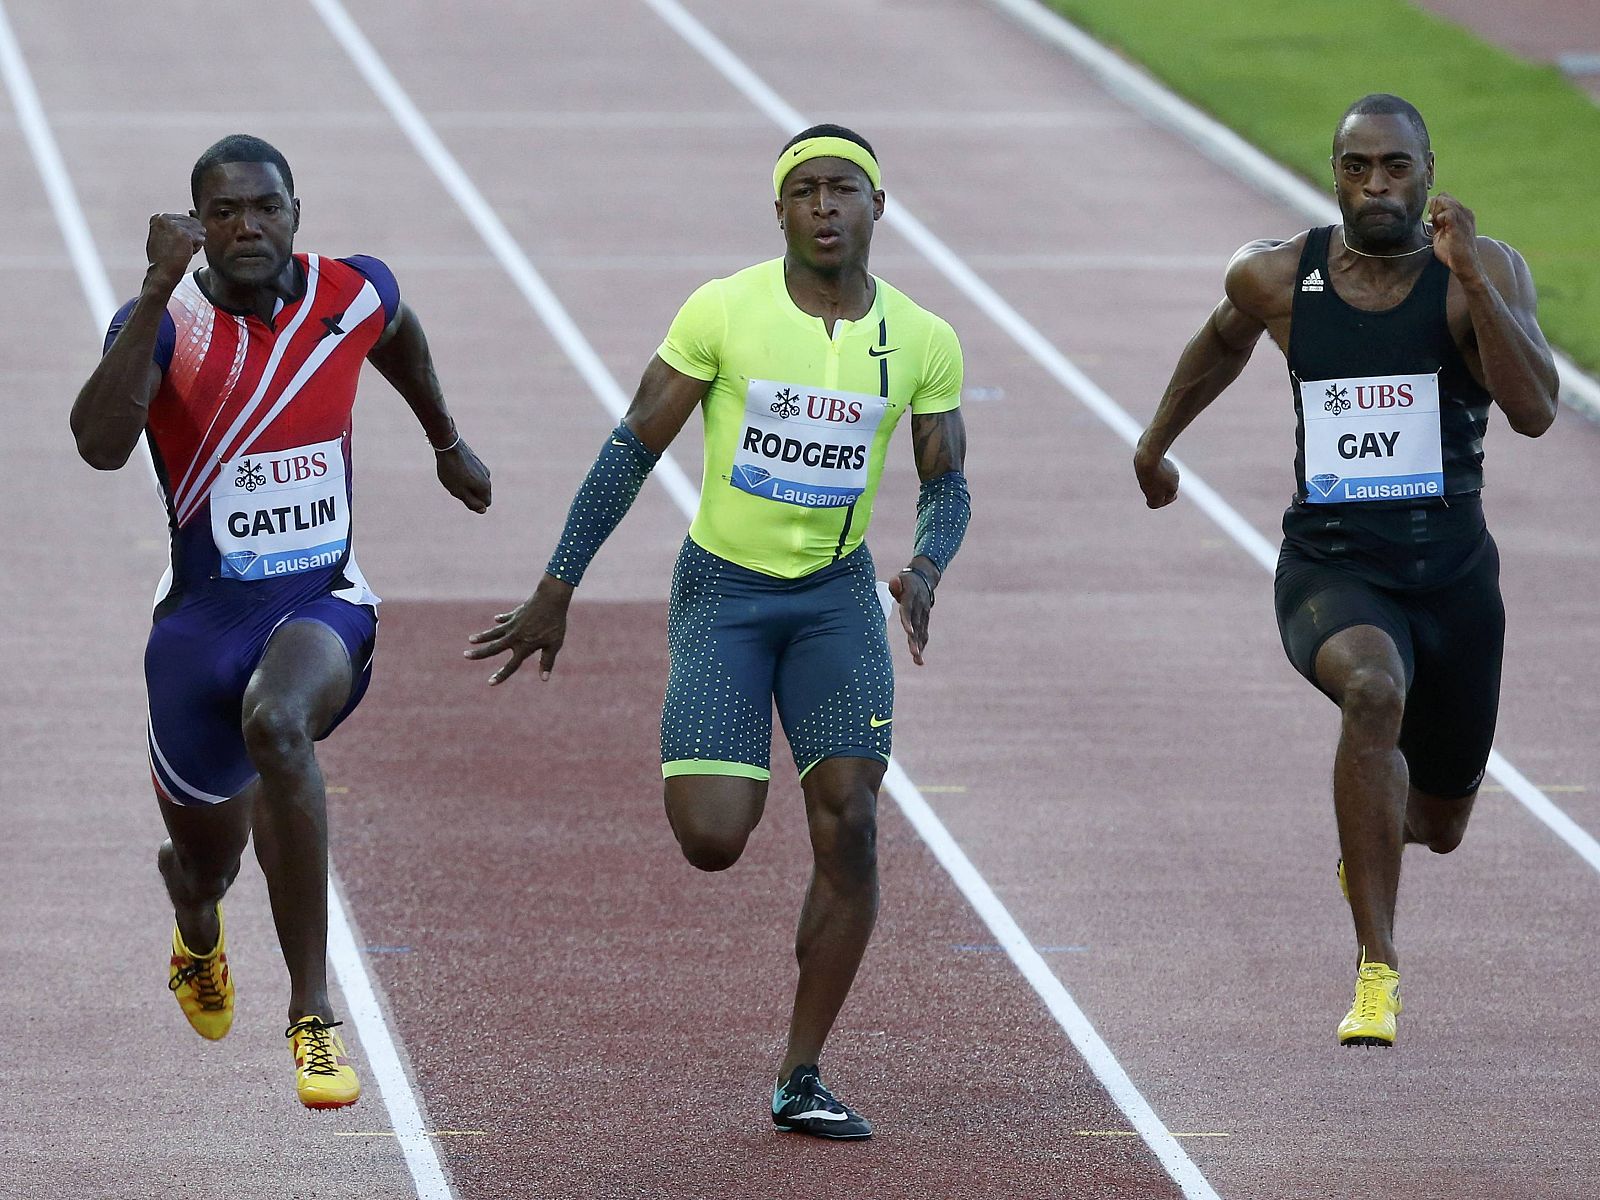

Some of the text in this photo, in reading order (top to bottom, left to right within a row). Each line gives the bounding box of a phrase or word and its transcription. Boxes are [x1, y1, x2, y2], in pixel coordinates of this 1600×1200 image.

[806, 395, 863, 424] UBS
[1355, 383, 1414, 410] UBS
[742, 426, 866, 470] RODGERS
[1337, 431, 1400, 460] GAY
[270, 452, 328, 484] UBS
[771, 482, 855, 506] Lausanne
[1344, 481, 1438, 499] Lausanne
[227, 496, 336, 538] GATLIN
[263, 549, 343, 576] Lausann
